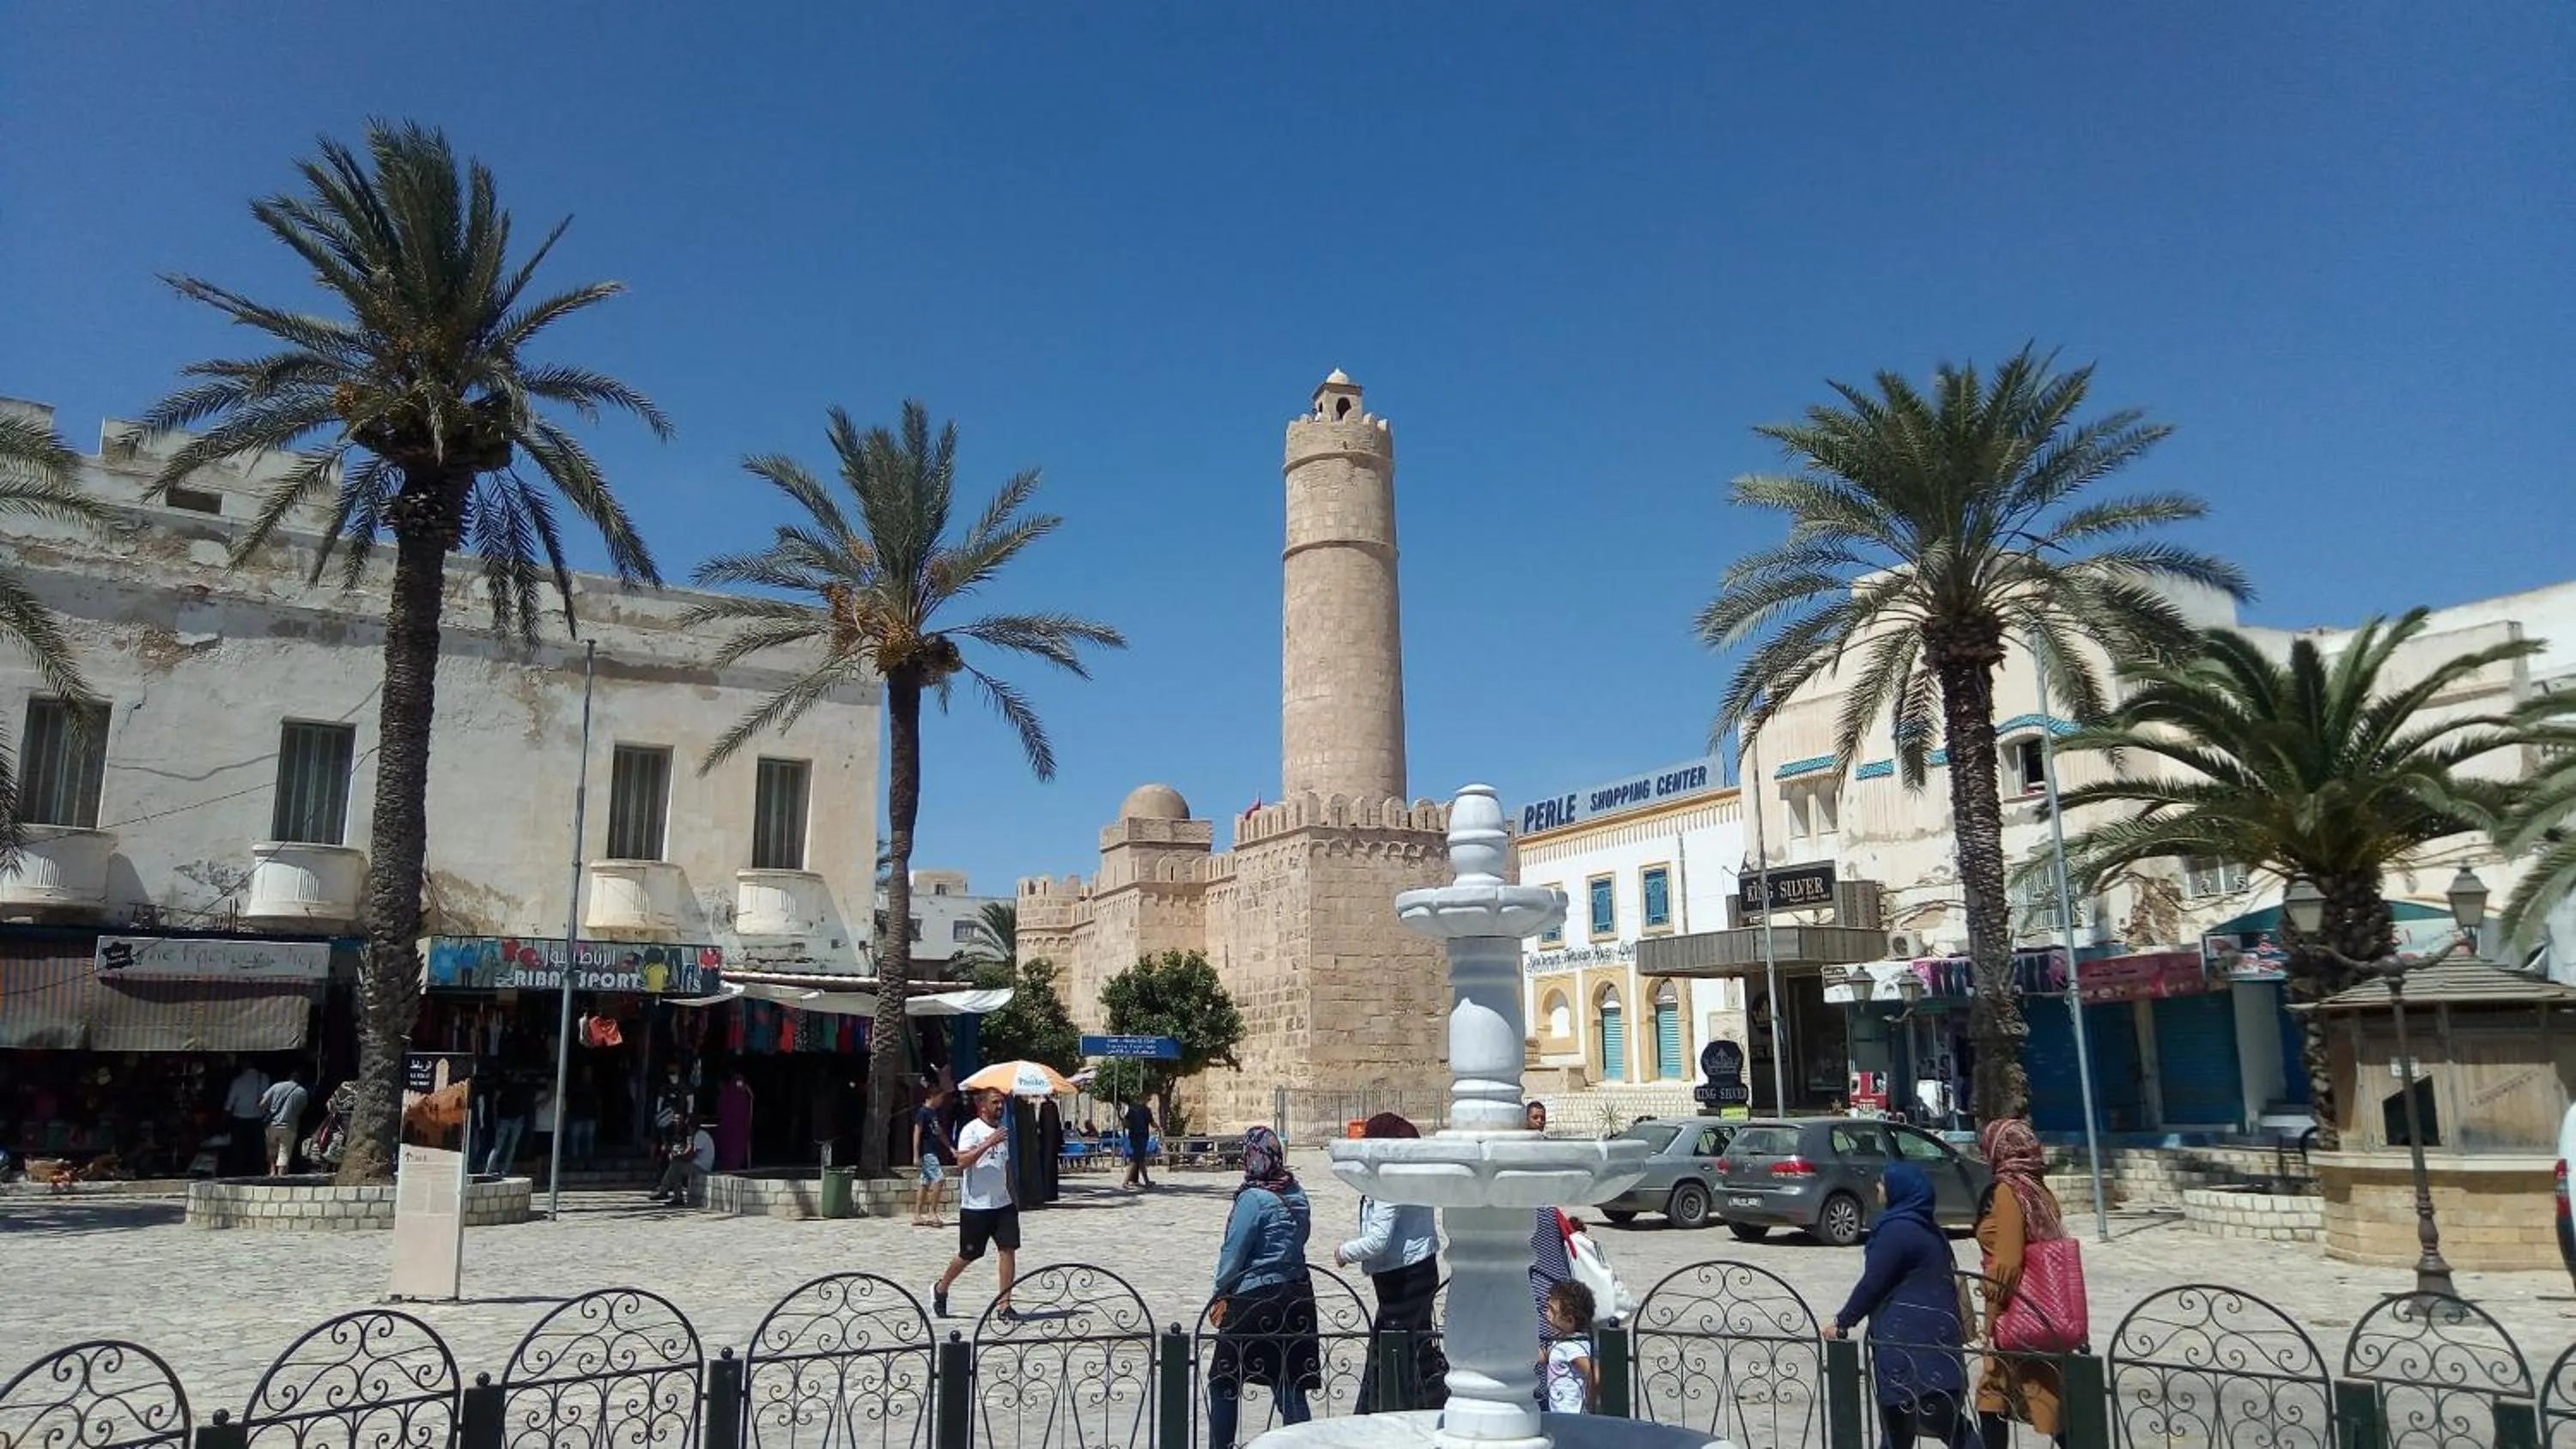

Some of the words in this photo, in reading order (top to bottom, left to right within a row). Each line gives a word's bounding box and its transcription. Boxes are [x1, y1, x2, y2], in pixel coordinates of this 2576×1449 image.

[1523, 794, 1577, 834] PERLE
[1589, 779, 1651, 812] SHOPPING
[1656, 765, 1708, 797] CENTER
[1778, 876, 1824, 899] SILVER
[515, 969, 576, 988] RIBA
[578, 970, 641, 989] SPORT
